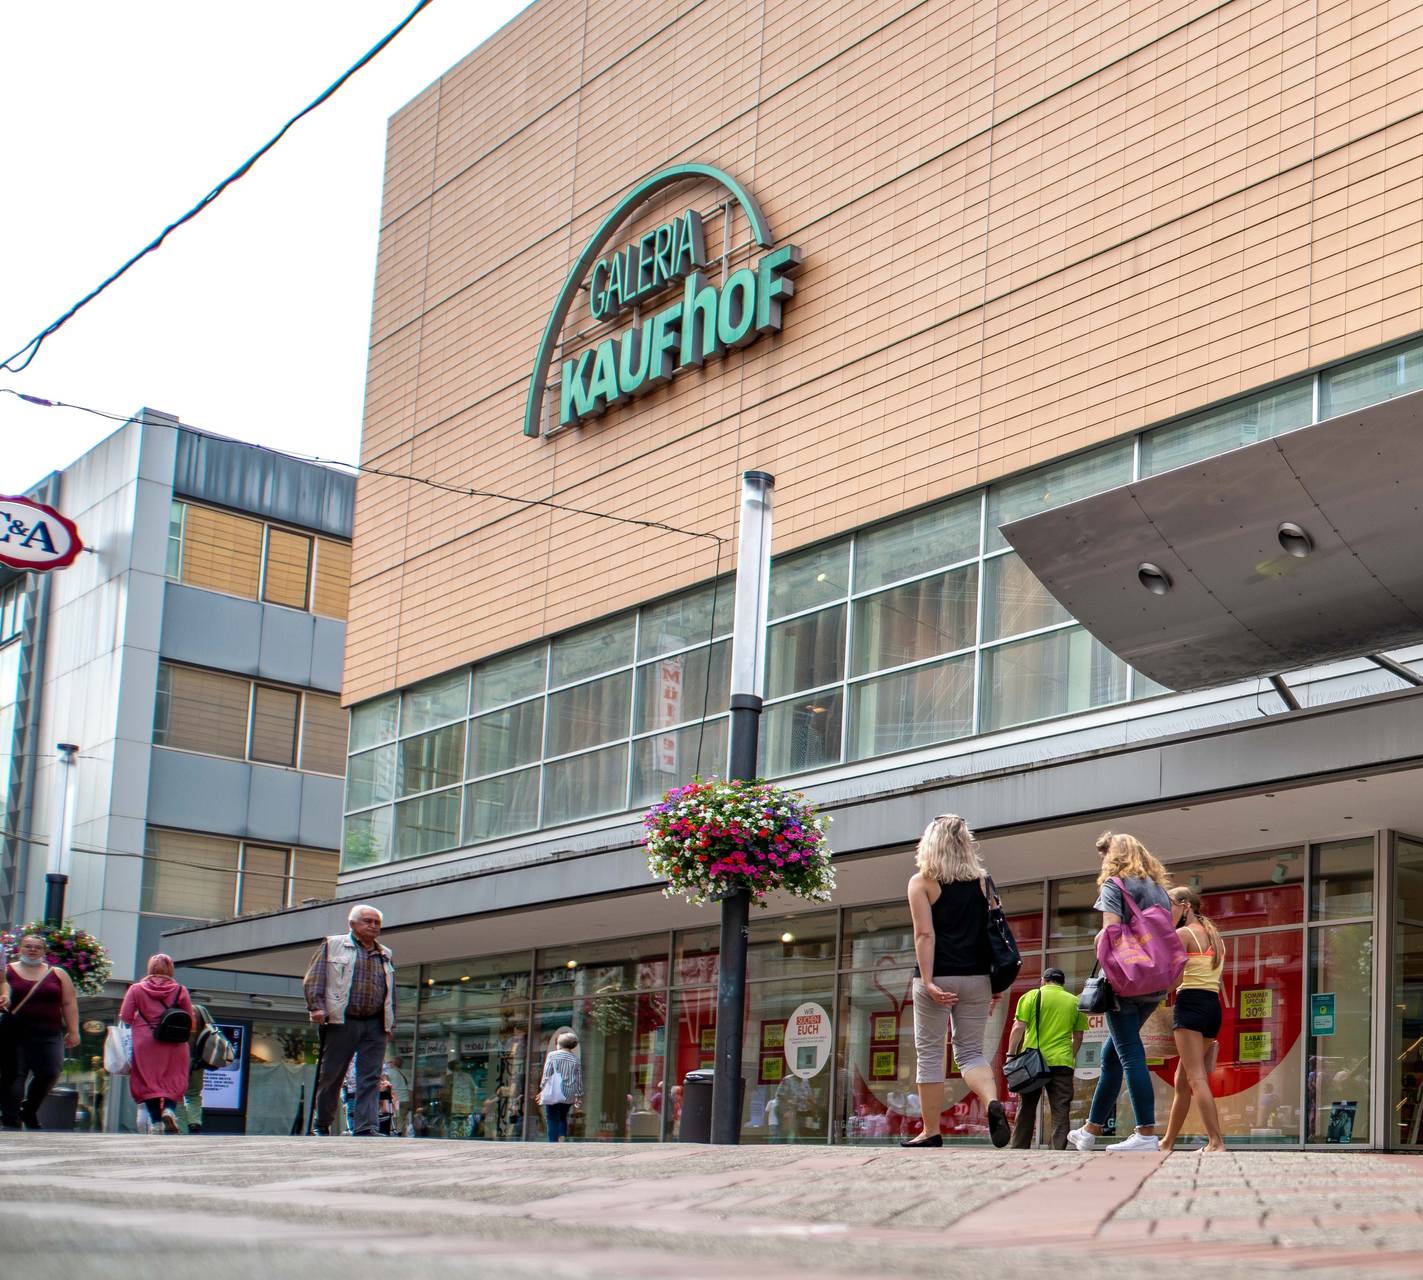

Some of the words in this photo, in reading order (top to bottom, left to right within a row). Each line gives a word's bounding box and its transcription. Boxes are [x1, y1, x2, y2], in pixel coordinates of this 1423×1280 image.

[590, 209, 704, 321] GALERIA
[1246, 1007, 1266, 1017] 30%
[1088, 1016, 1104, 1028] CH
[797, 1025, 819, 1035] EUCH
